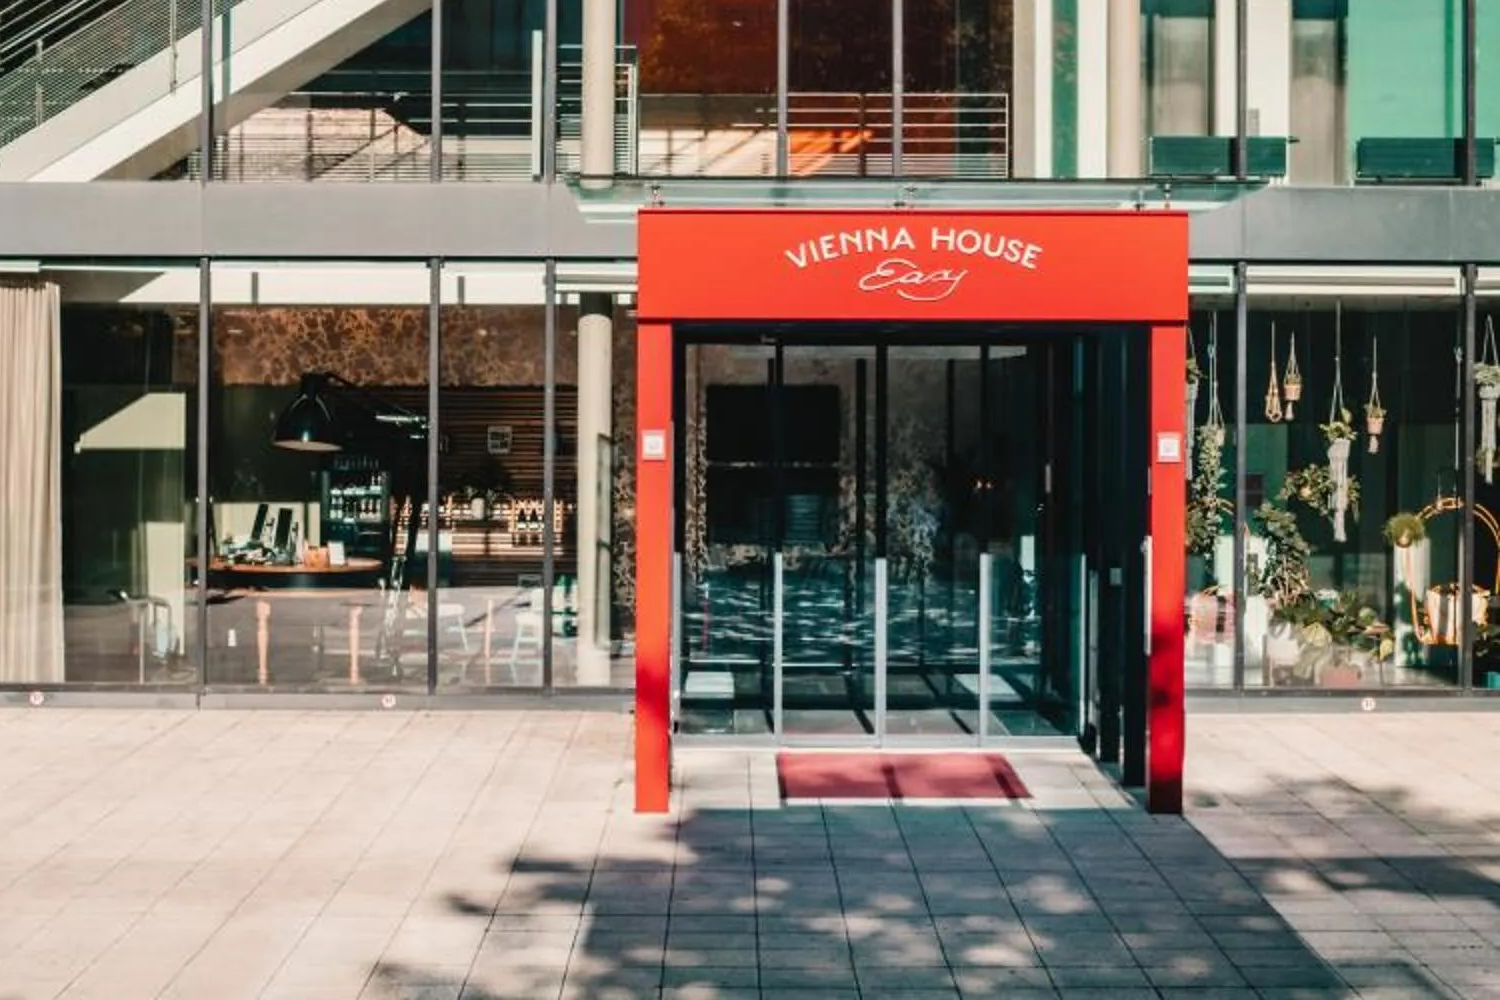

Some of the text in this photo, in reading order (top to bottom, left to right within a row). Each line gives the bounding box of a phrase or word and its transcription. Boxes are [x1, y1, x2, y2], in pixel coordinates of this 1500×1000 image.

[784, 226, 1043, 269] VIENNA HOUSE
[858, 257, 968, 301] Easy
